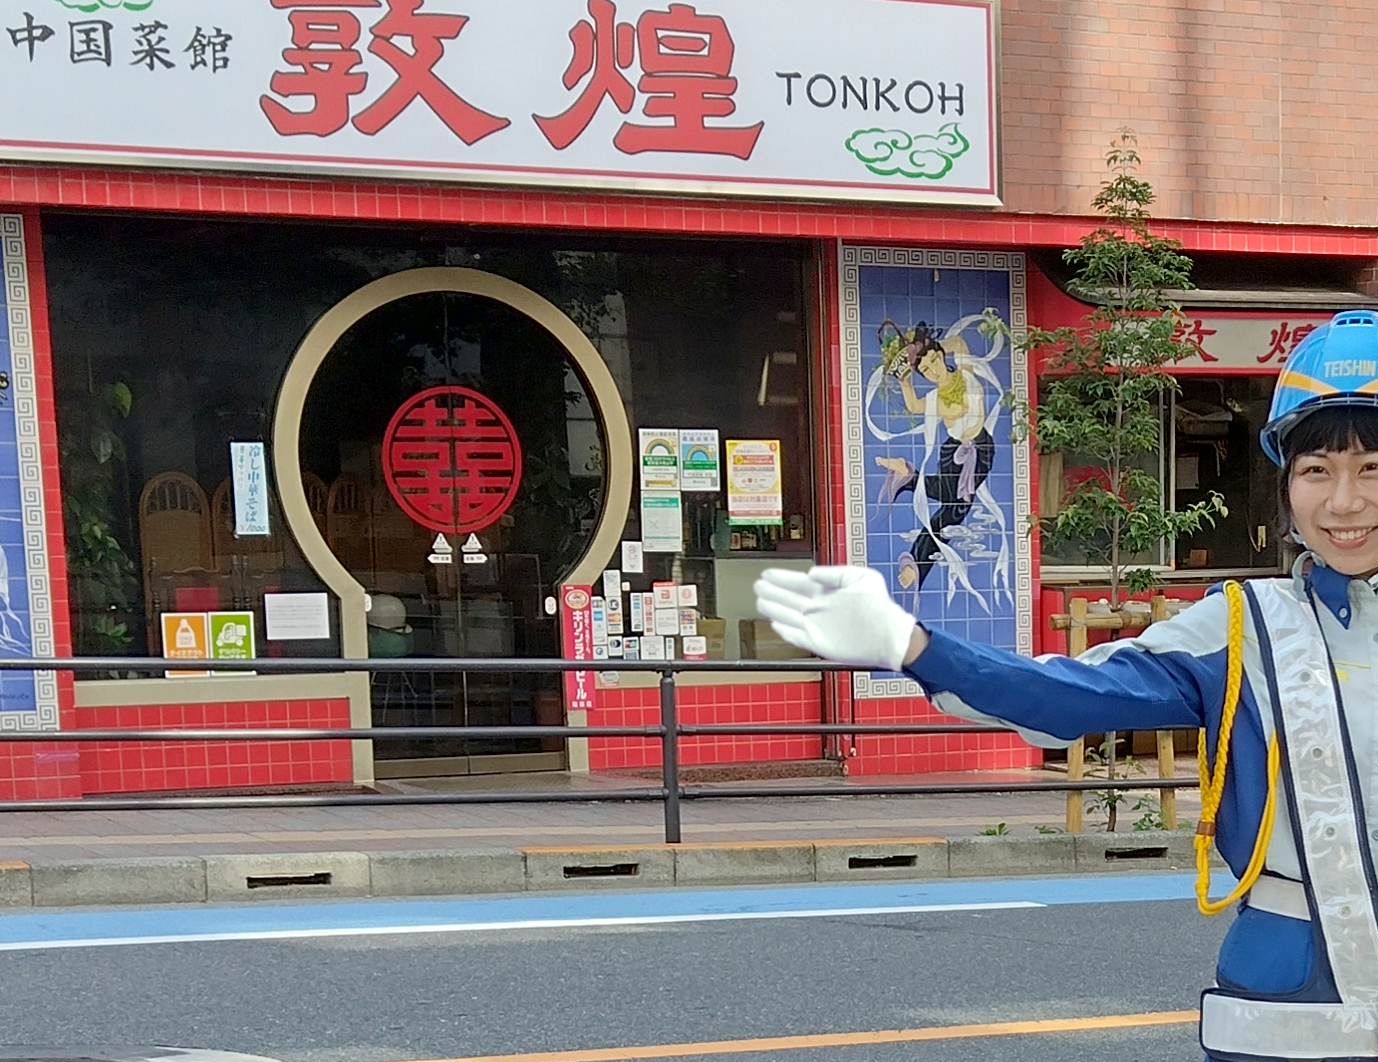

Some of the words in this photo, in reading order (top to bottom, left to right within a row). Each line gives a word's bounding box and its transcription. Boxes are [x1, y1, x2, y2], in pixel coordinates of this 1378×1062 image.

[7, 12, 233, 73] 中国菜館
[776, 72, 965, 117] TONKOH
[1324, 359, 1376, 378] TEISHIN
